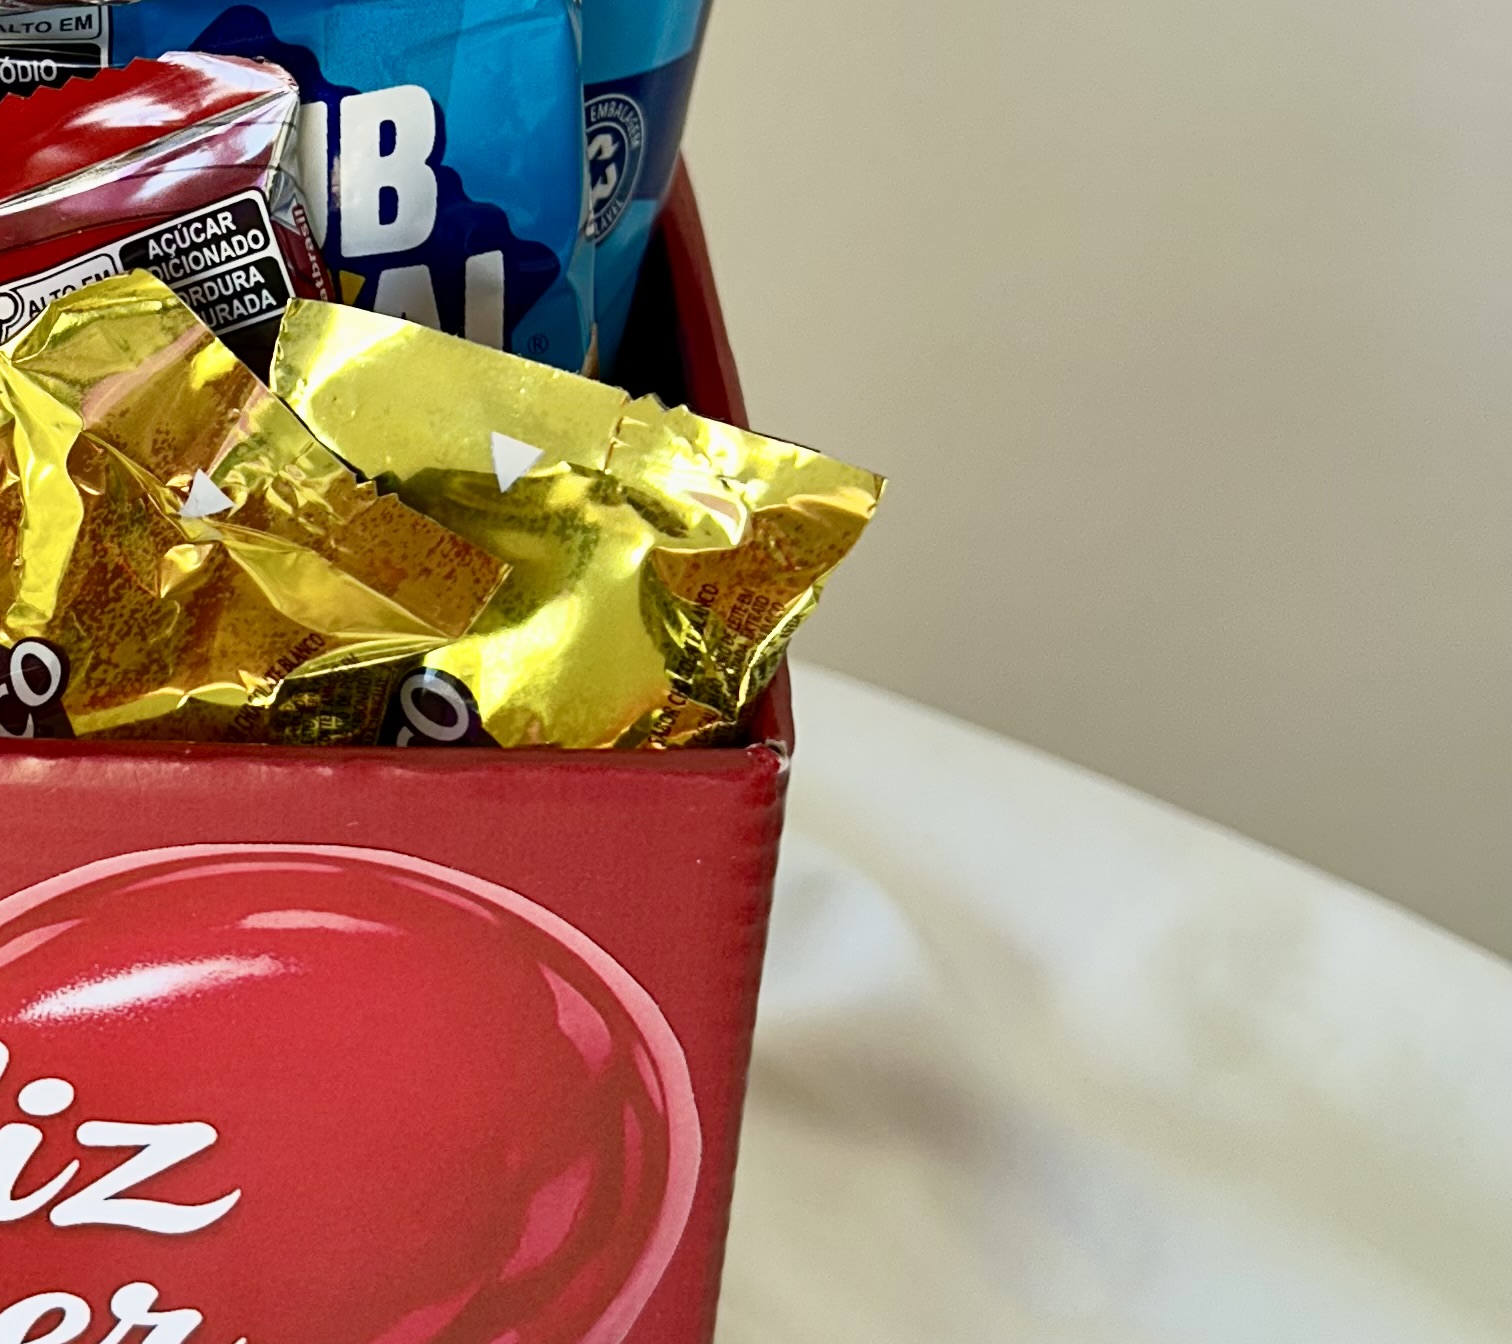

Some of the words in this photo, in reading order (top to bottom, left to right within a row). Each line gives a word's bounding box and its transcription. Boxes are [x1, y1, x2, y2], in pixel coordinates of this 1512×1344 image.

[59, 14, 93, 32] EM
[146, 210, 237, 260] AÇÚCAR
[149, 228, 265, 281] DICIONADO
[292, 206, 328, 302] atbrasil
[180, 265, 265, 307] ORDURA
[277, 631, 325, 674] BLANCO
